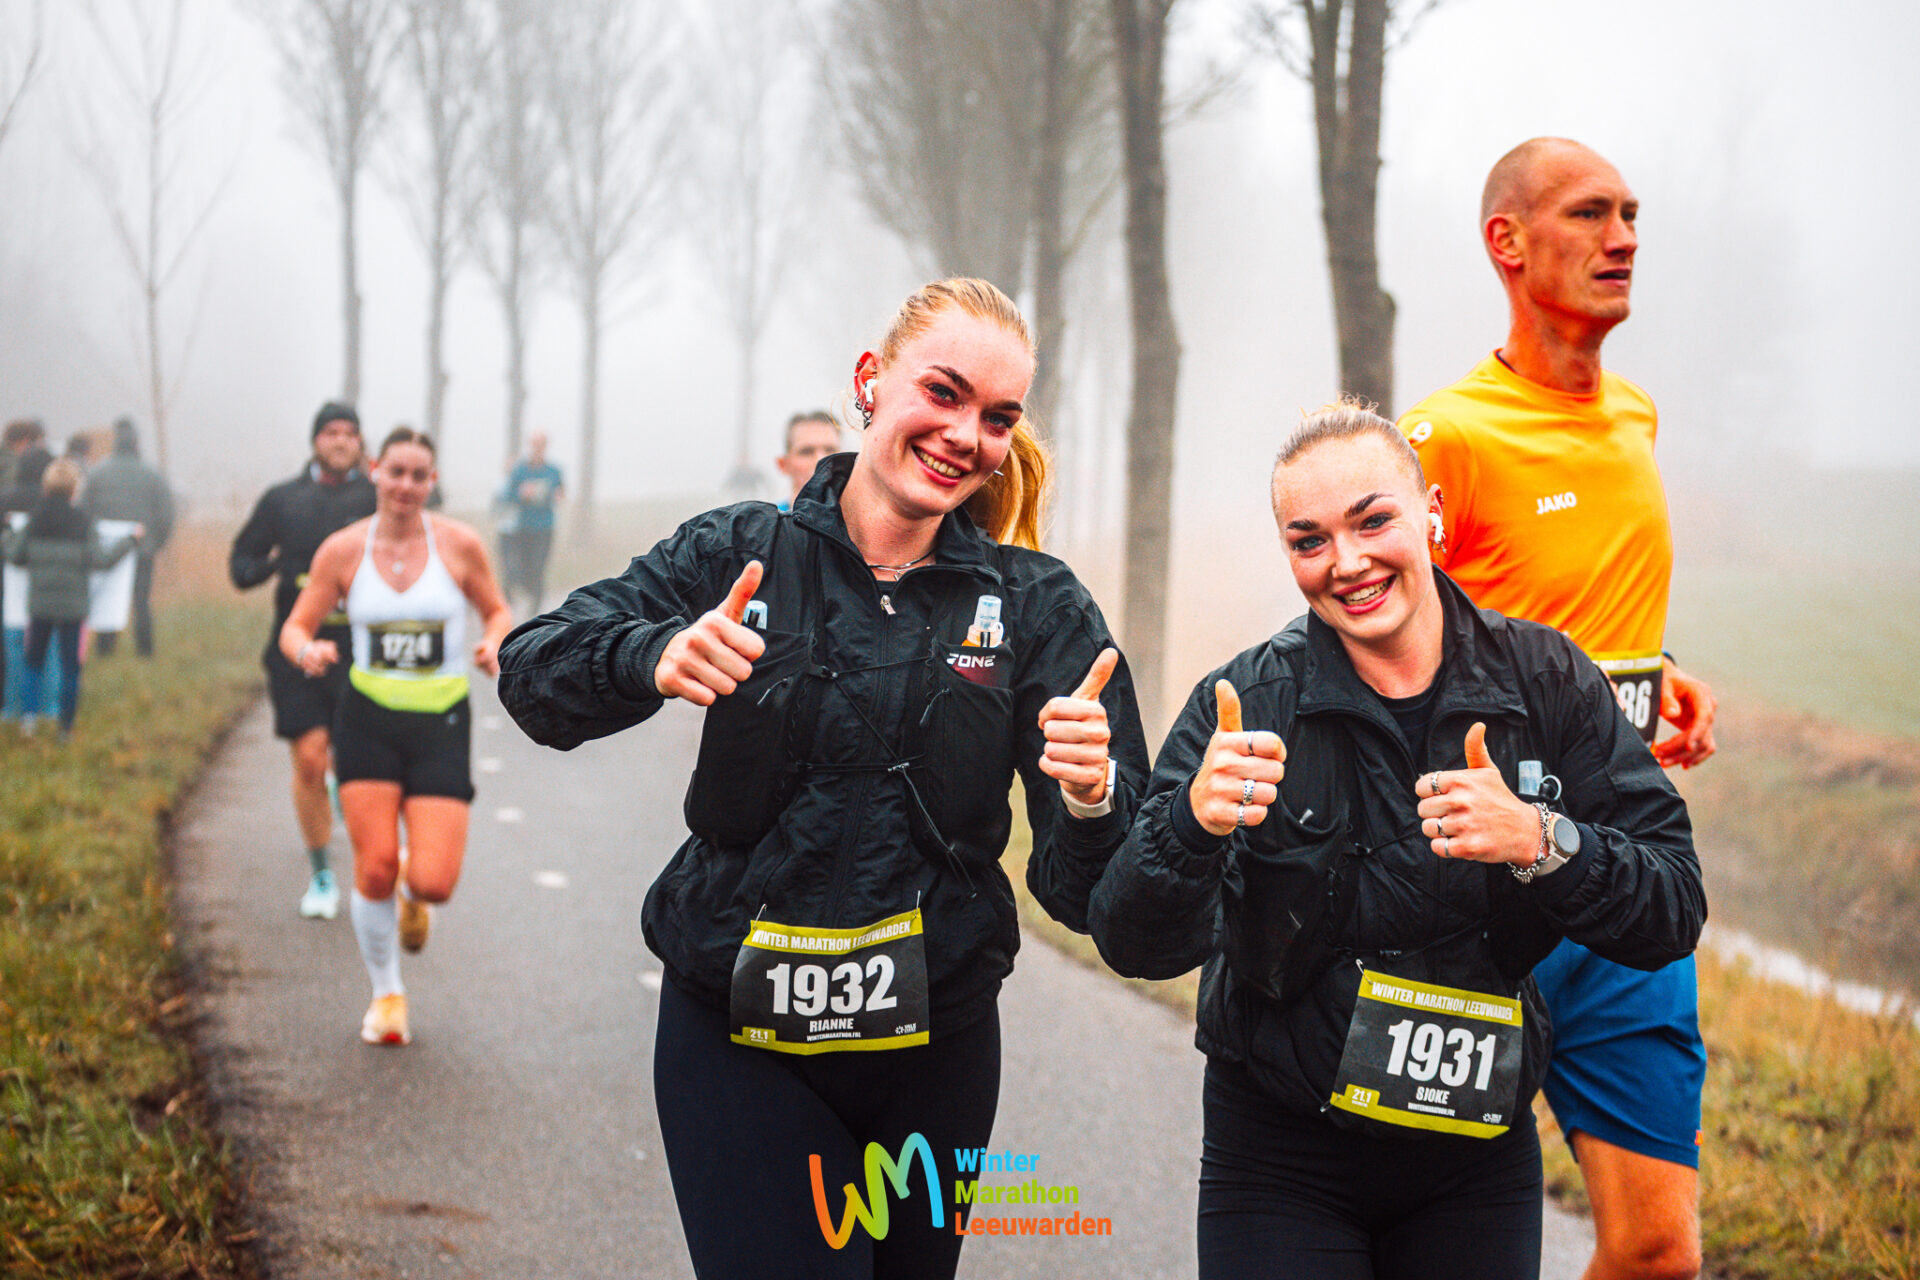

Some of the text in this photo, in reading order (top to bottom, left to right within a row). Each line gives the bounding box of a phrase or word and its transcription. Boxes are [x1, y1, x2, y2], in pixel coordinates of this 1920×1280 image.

[1536, 492, 1577, 515] JAKO
[752, 920, 911, 951] WINTER MARATHON LEEUWARDEN
[766, 954, 898, 1017] 1932
[1371, 981, 1413, 1003] WINTER
[1414, 992, 1465, 1013] MARATHON
[750, 1029, 768, 1040] 21.1
[809, 1017, 854, 1033] RIANNE
[1386, 1019, 1496, 1091] 1931
[1351, 1088, 1372, 1103] 21.1
